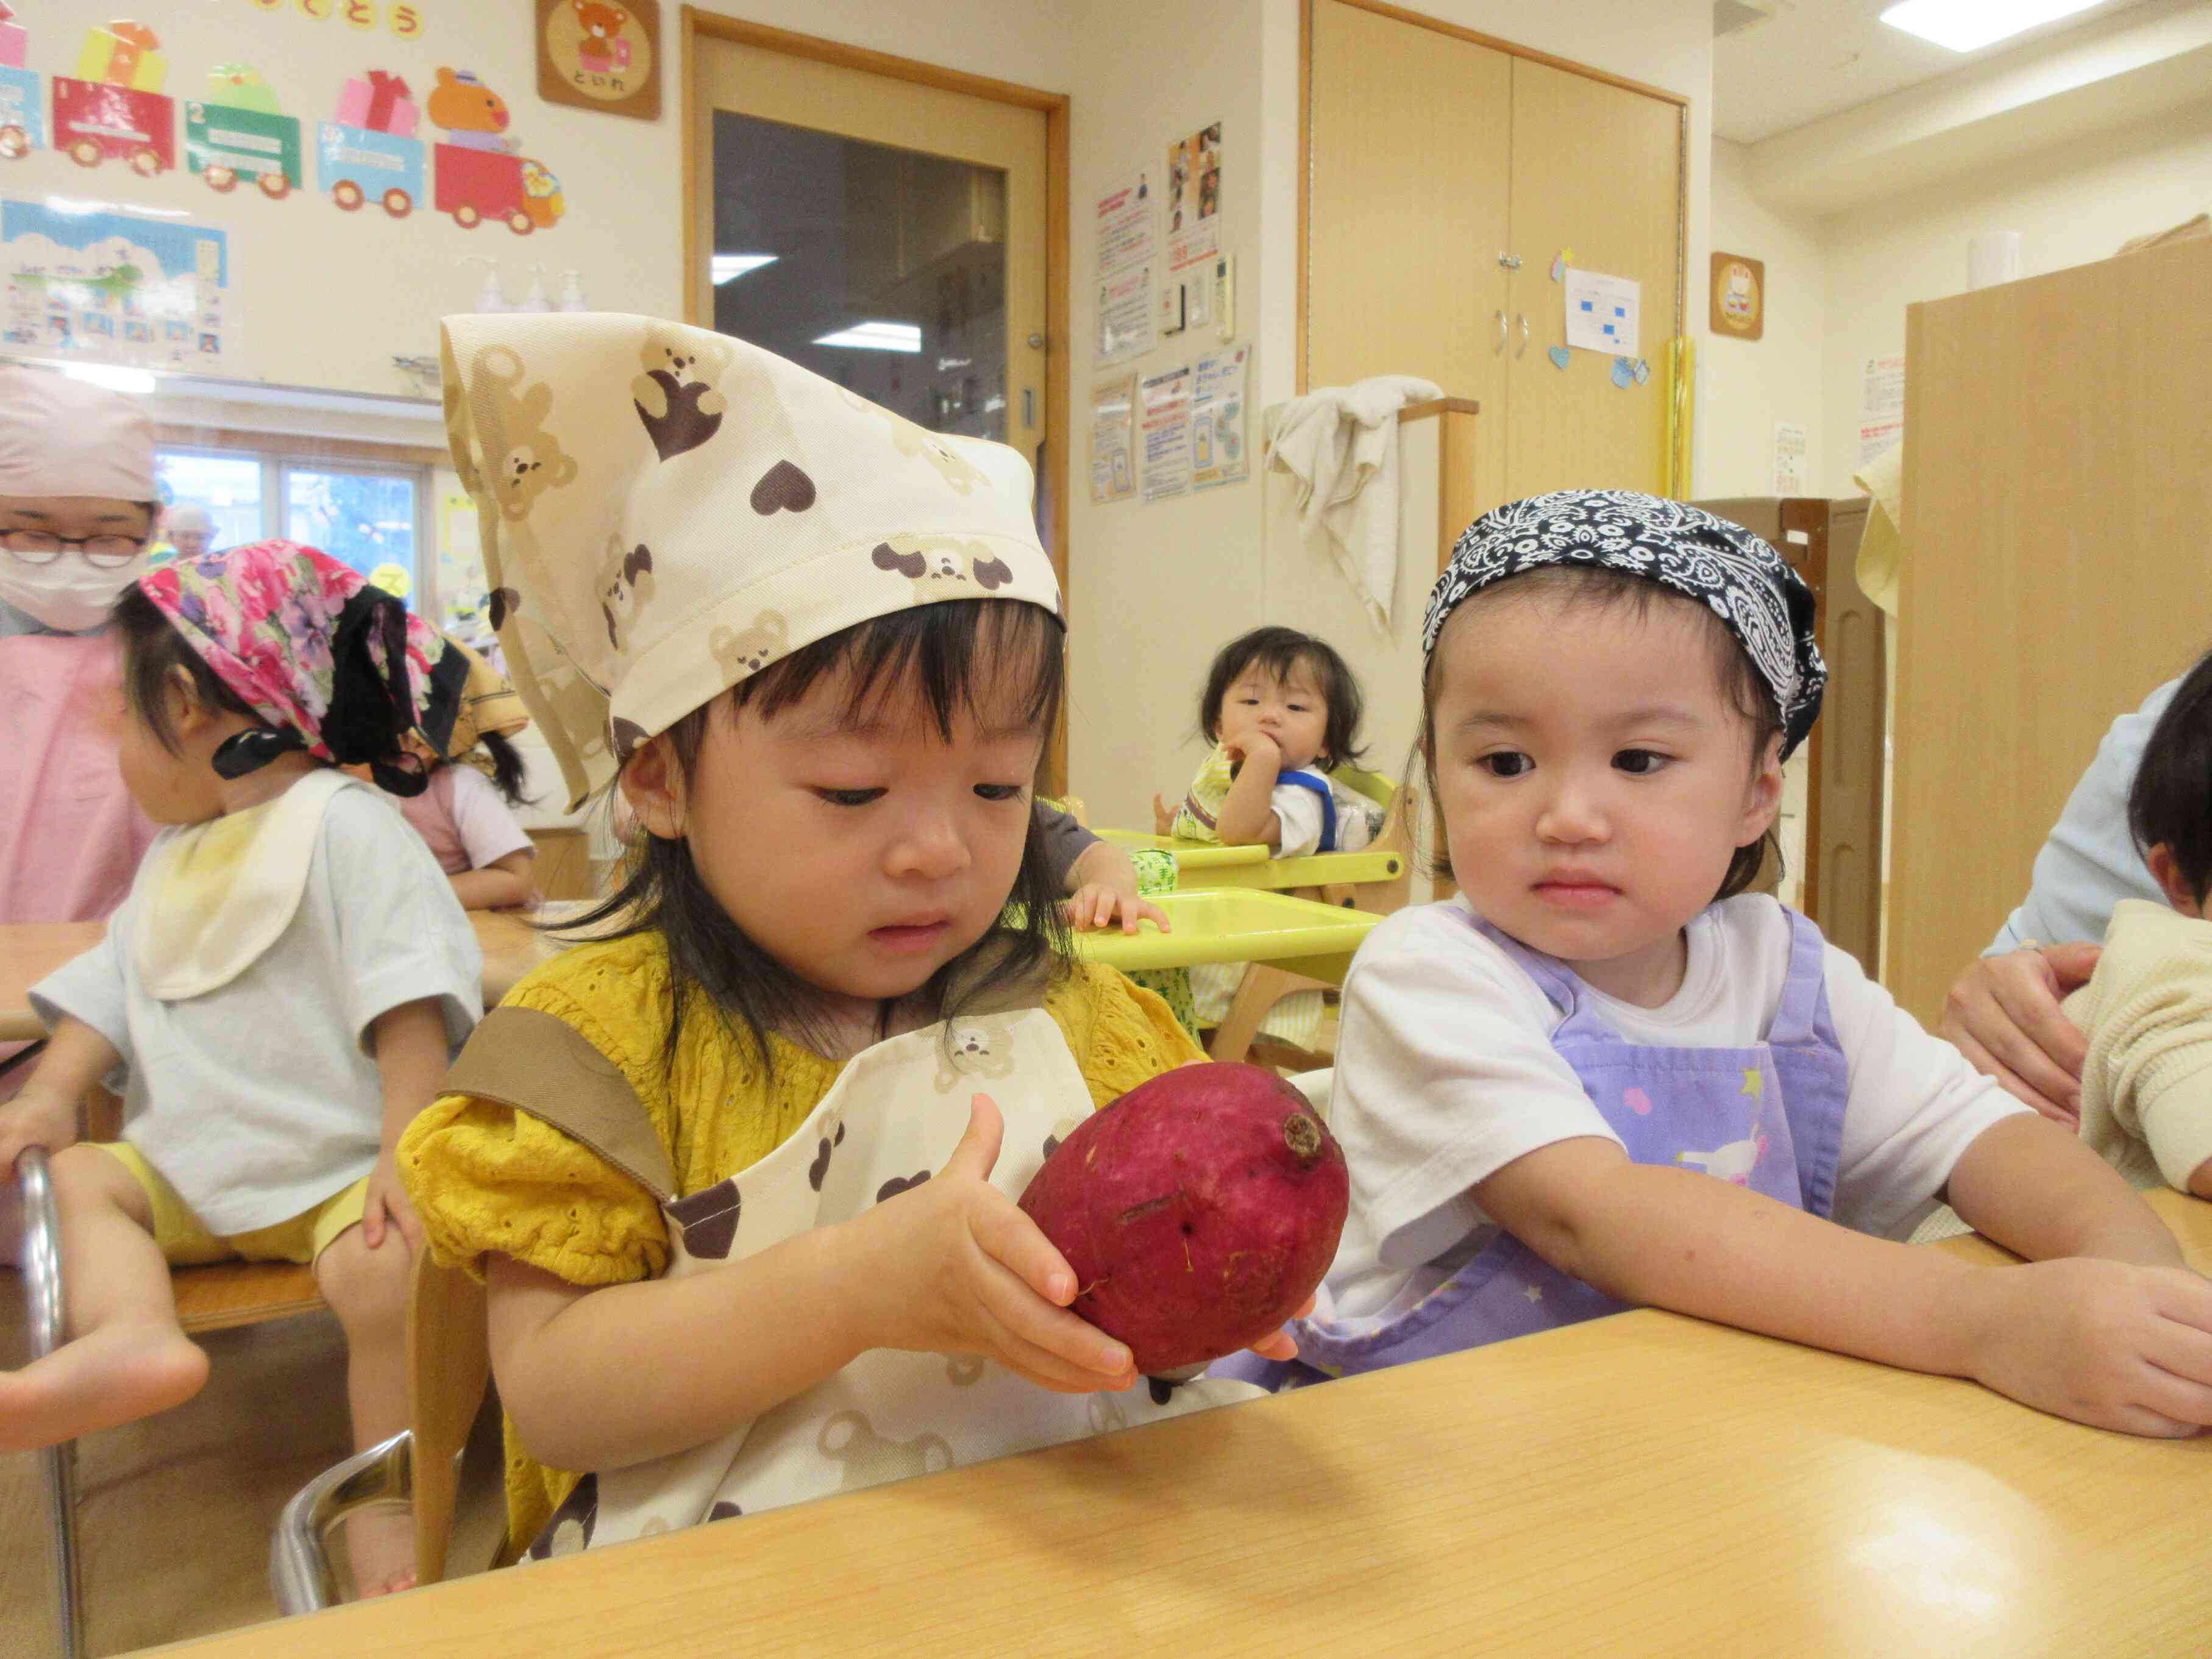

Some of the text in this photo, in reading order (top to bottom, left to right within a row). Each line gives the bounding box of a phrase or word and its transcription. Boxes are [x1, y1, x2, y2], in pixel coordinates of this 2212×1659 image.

[574, 68, 625, 91] といれ
[188, 102, 205, 124] 2
